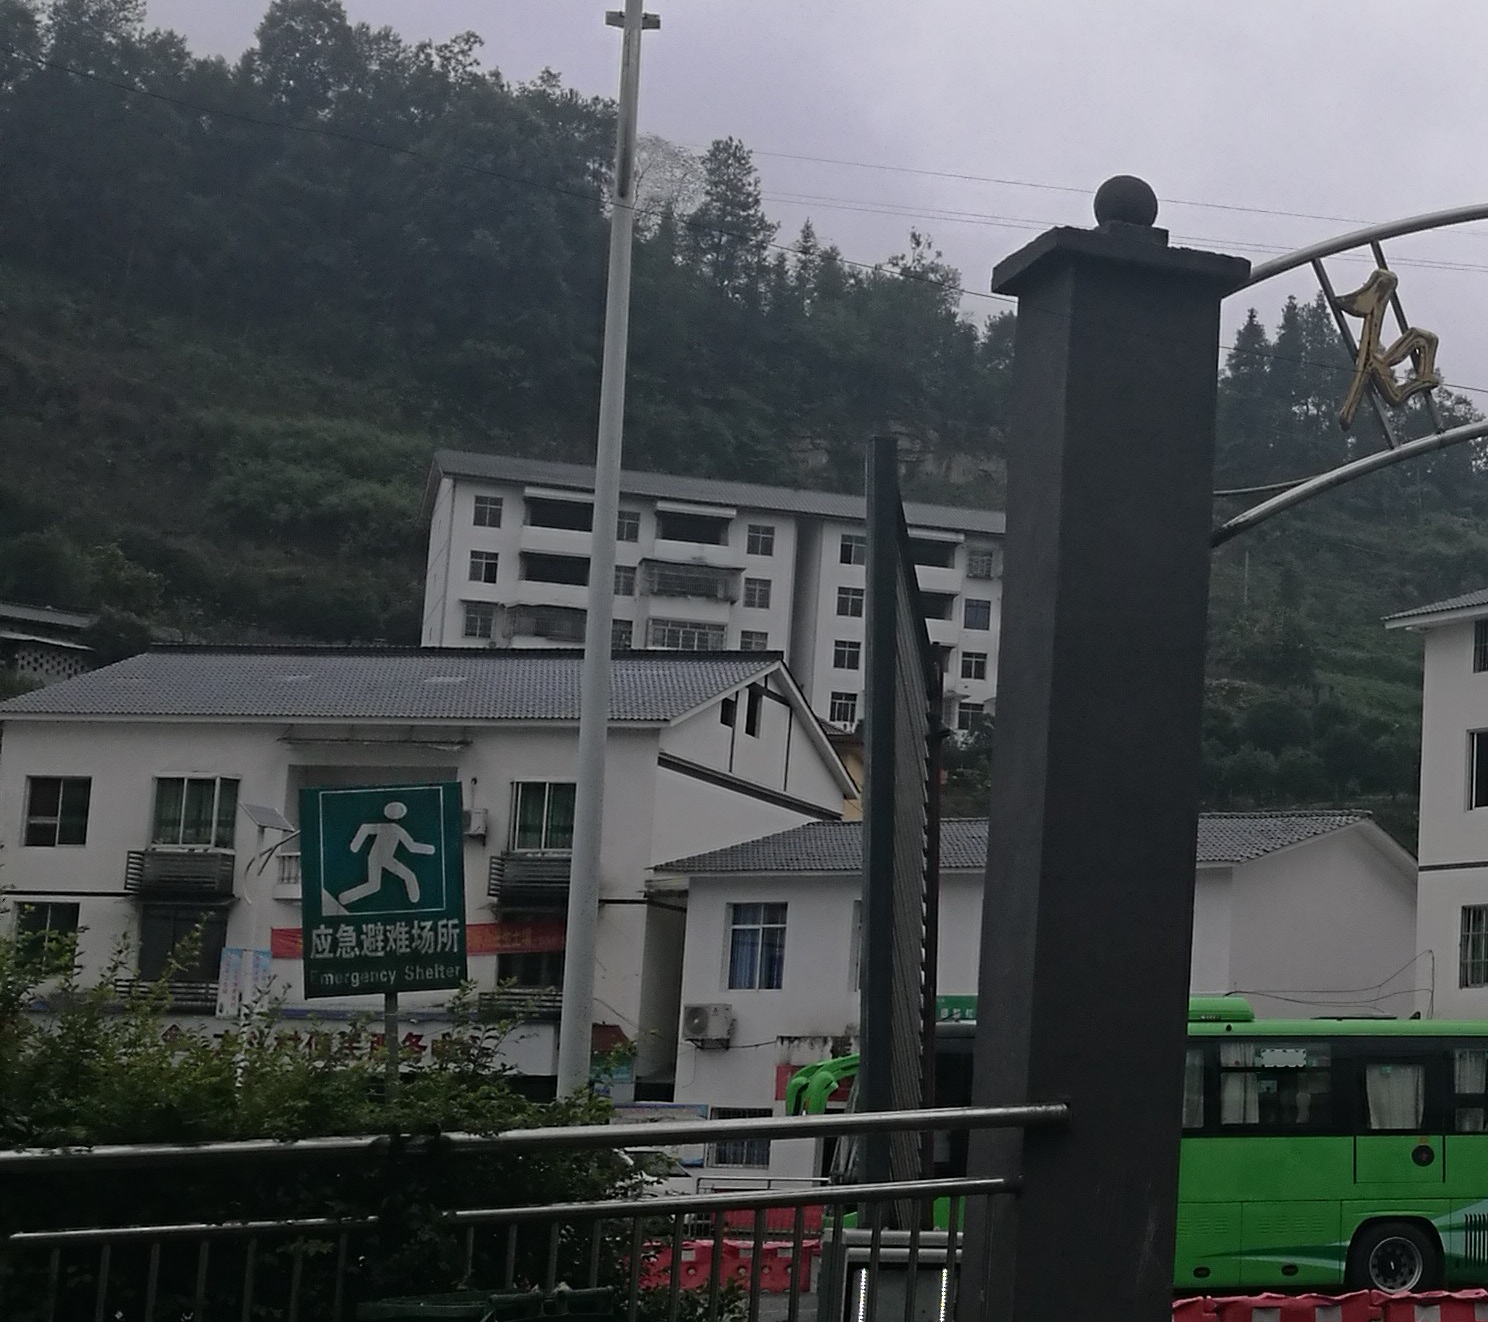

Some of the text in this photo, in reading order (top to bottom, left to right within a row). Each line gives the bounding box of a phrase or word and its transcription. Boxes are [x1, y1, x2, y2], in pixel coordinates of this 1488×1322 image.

[310, 918, 460, 959] 应急避难场所
[404, 963, 461, 981] Shelter
